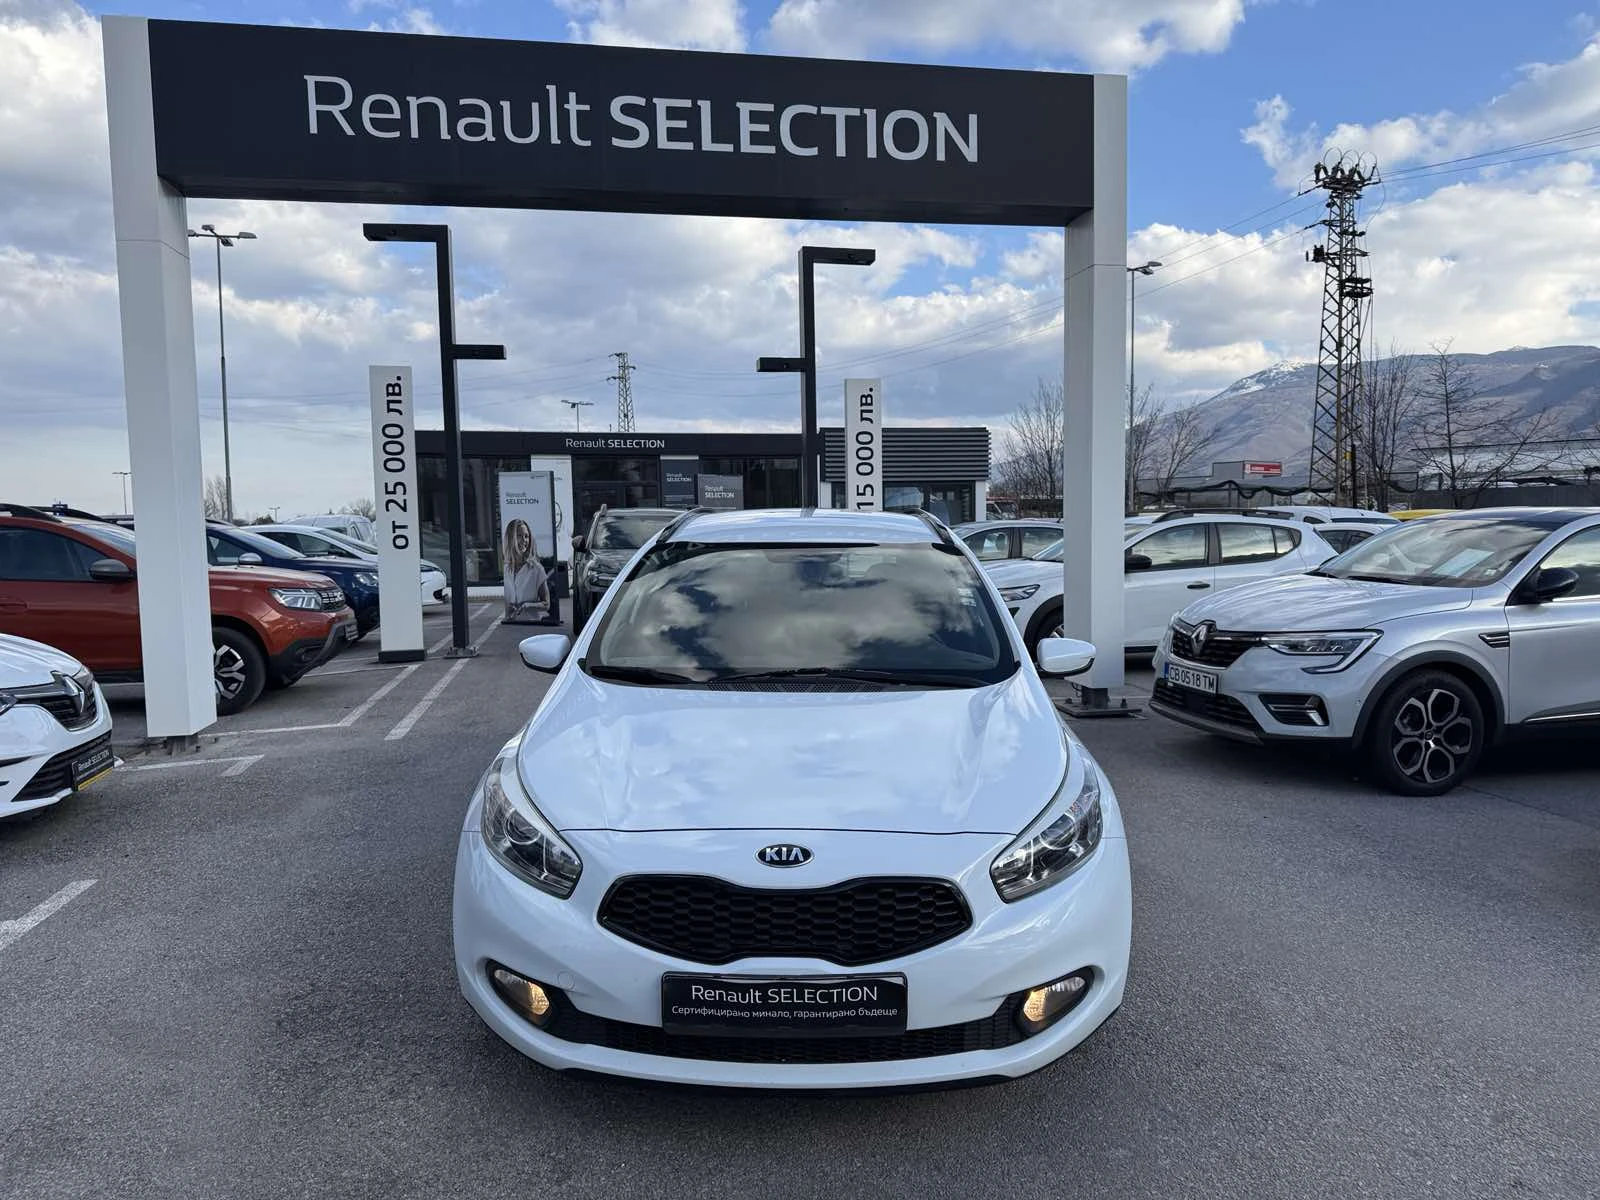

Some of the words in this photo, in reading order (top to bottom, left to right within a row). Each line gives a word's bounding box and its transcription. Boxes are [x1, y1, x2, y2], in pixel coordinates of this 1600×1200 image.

[303, 74, 592, 147] Renault
[609, 95, 979, 163] SELECTION
[386, 375, 403, 416] лв.
[860, 387, 874, 424] лв.
[382, 423, 405, 473] 000
[565, 438, 606, 448] Renault
[607, 439, 665, 449] SELECTION
[855, 430, 875, 477] 000
[385, 481, 408, 513] 25
[704, 491, 735, 499] SELECTION
[856, 483, 875, 510] 15
[392, 520, 409, 549] от
[1181, 670, 1201, 687] 0518
[765, 846, 804, 862] KIA
[691, 984, 763, 1004] Renault
[767, 985, 879, 1005] SELECTION
[671, 1005, 750, 1018] Сертифицирано
[752, 1008, 793, 1020] минало,
[793, 1008, 856, 1020] гарантирано
[858, 1006, 899, 1018] бъдеще
